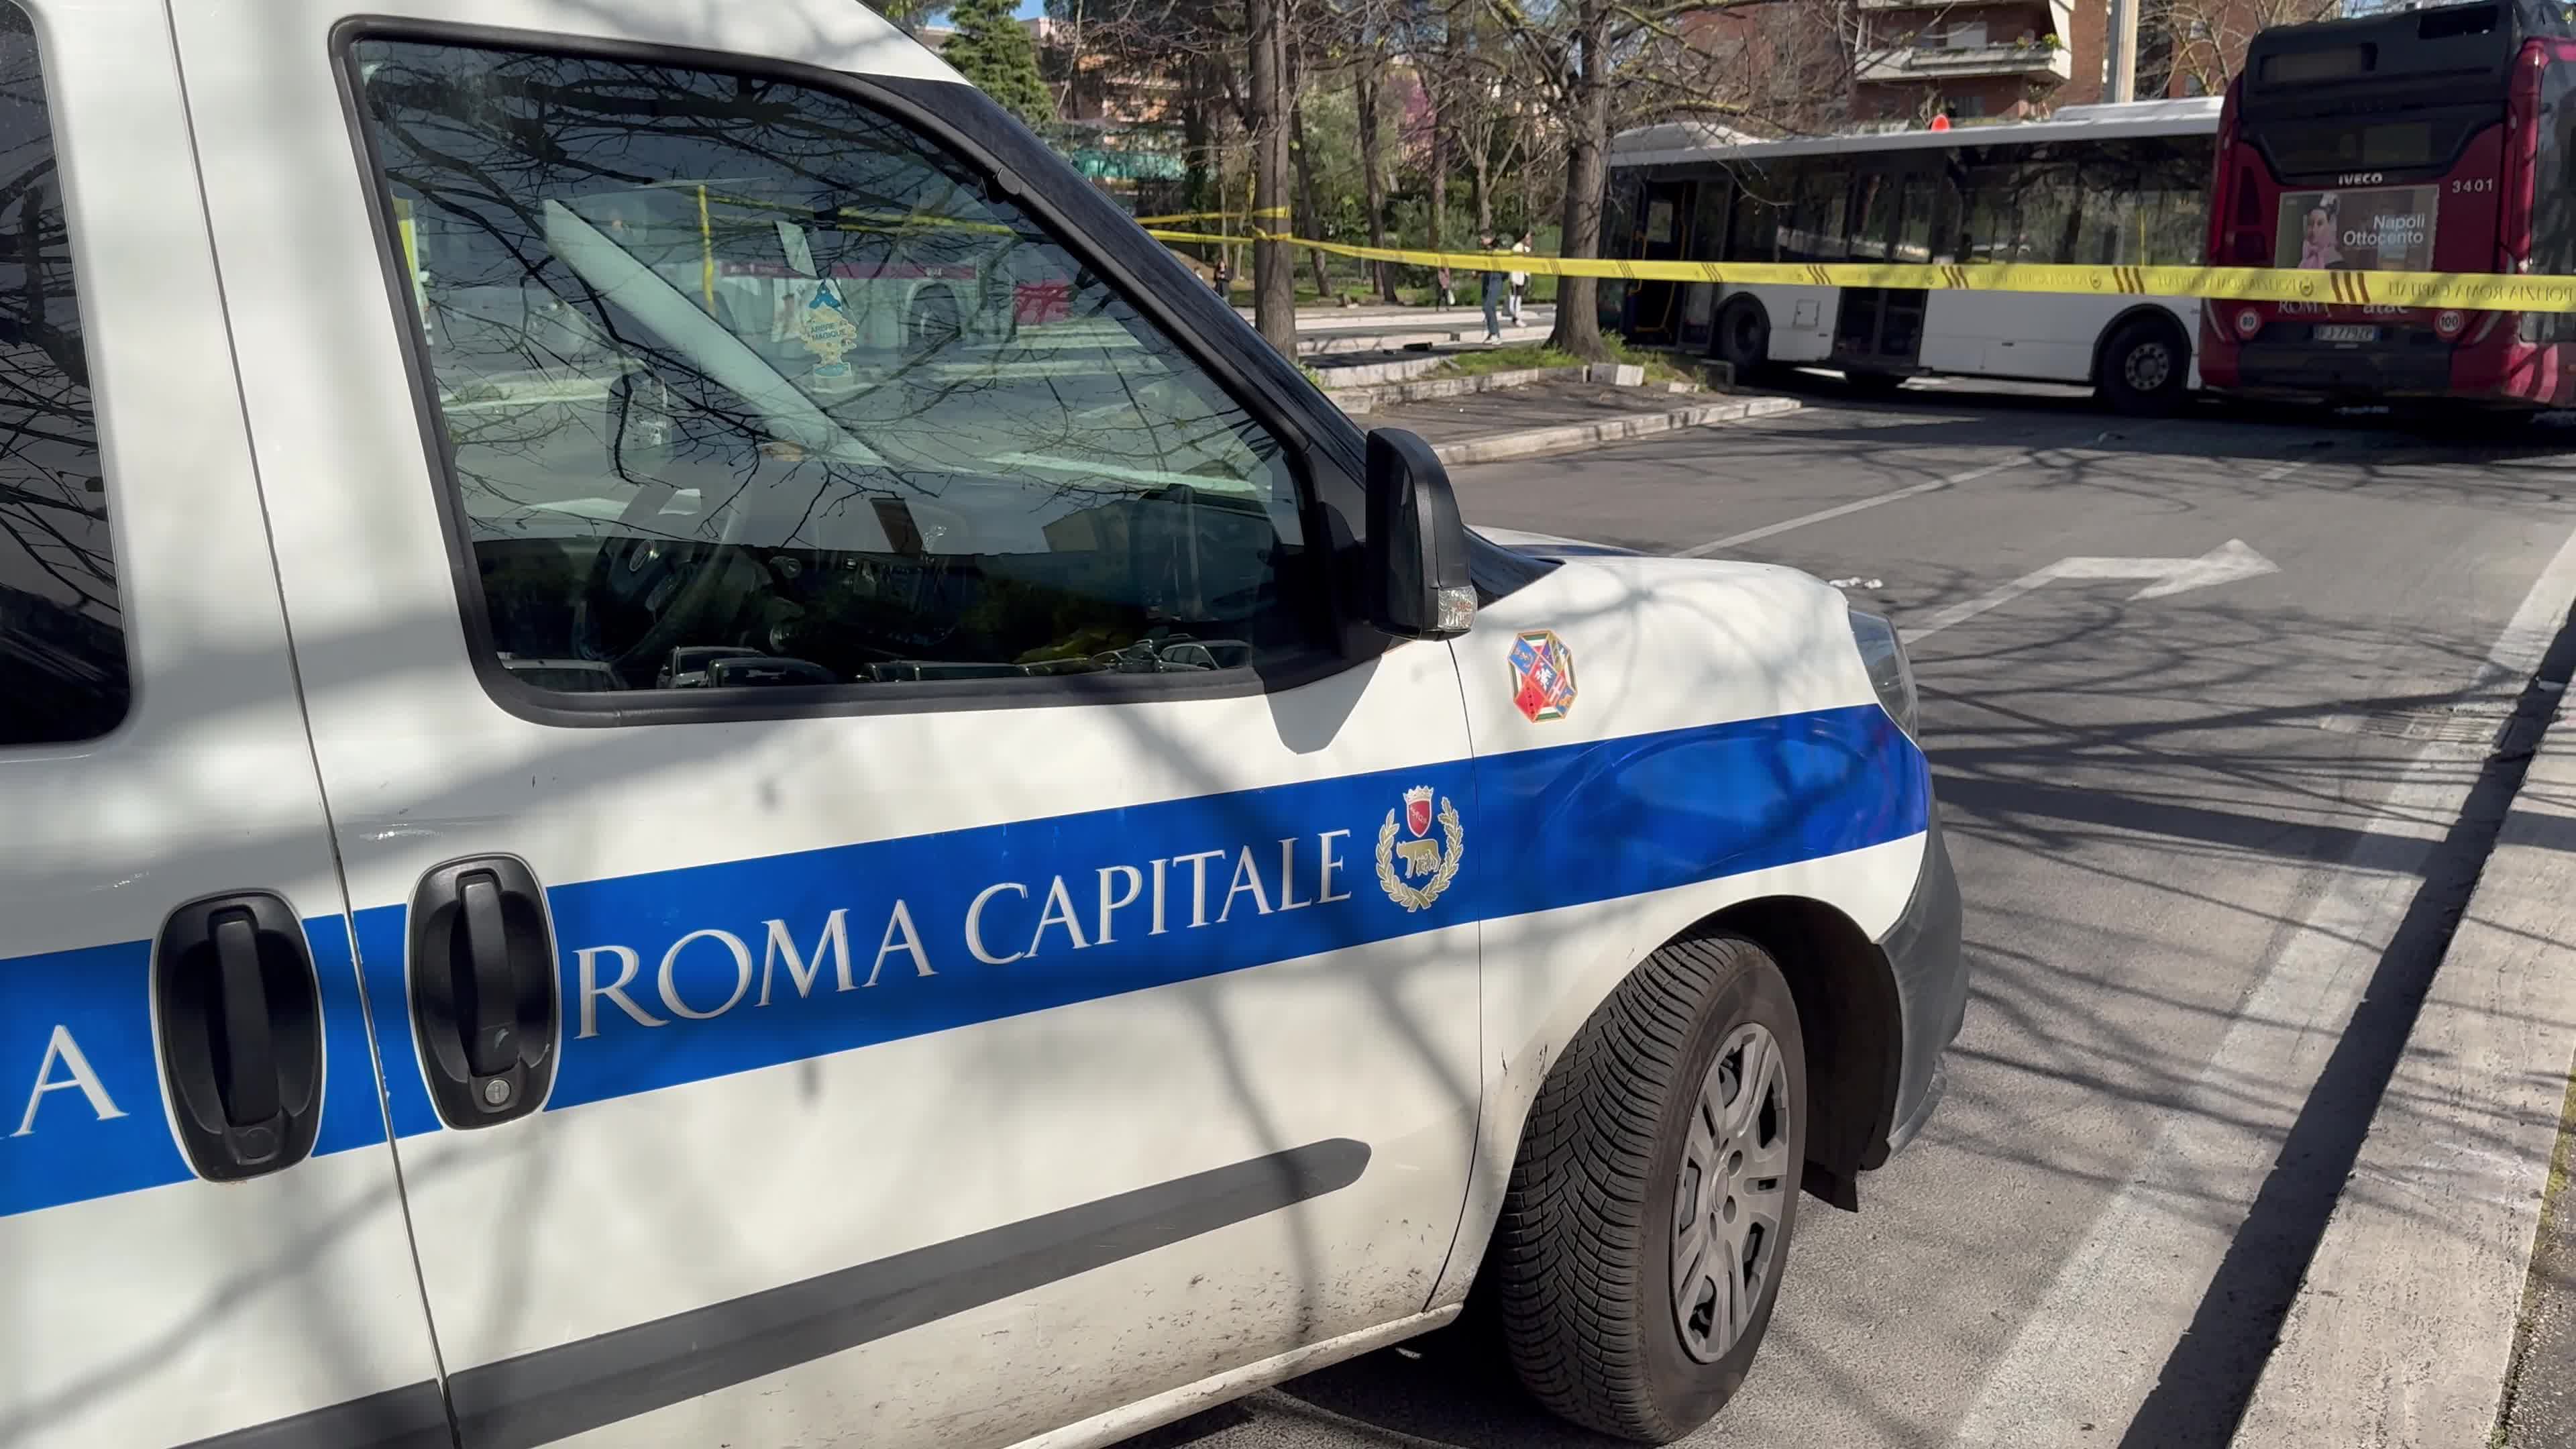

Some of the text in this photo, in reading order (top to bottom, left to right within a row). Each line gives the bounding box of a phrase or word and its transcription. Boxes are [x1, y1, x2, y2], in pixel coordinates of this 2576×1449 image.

[2339, 172, 2383, 185] IVECO
[2452, 178, 2493, 193] 3401
[2373, 214, 2425, 231] Napoli
[2343, 230, 2424, 246] Ottocento
[2442, 315, 2458, 327] 100
[0, 828, 1353, 1138] A ROMA CAPITALE
